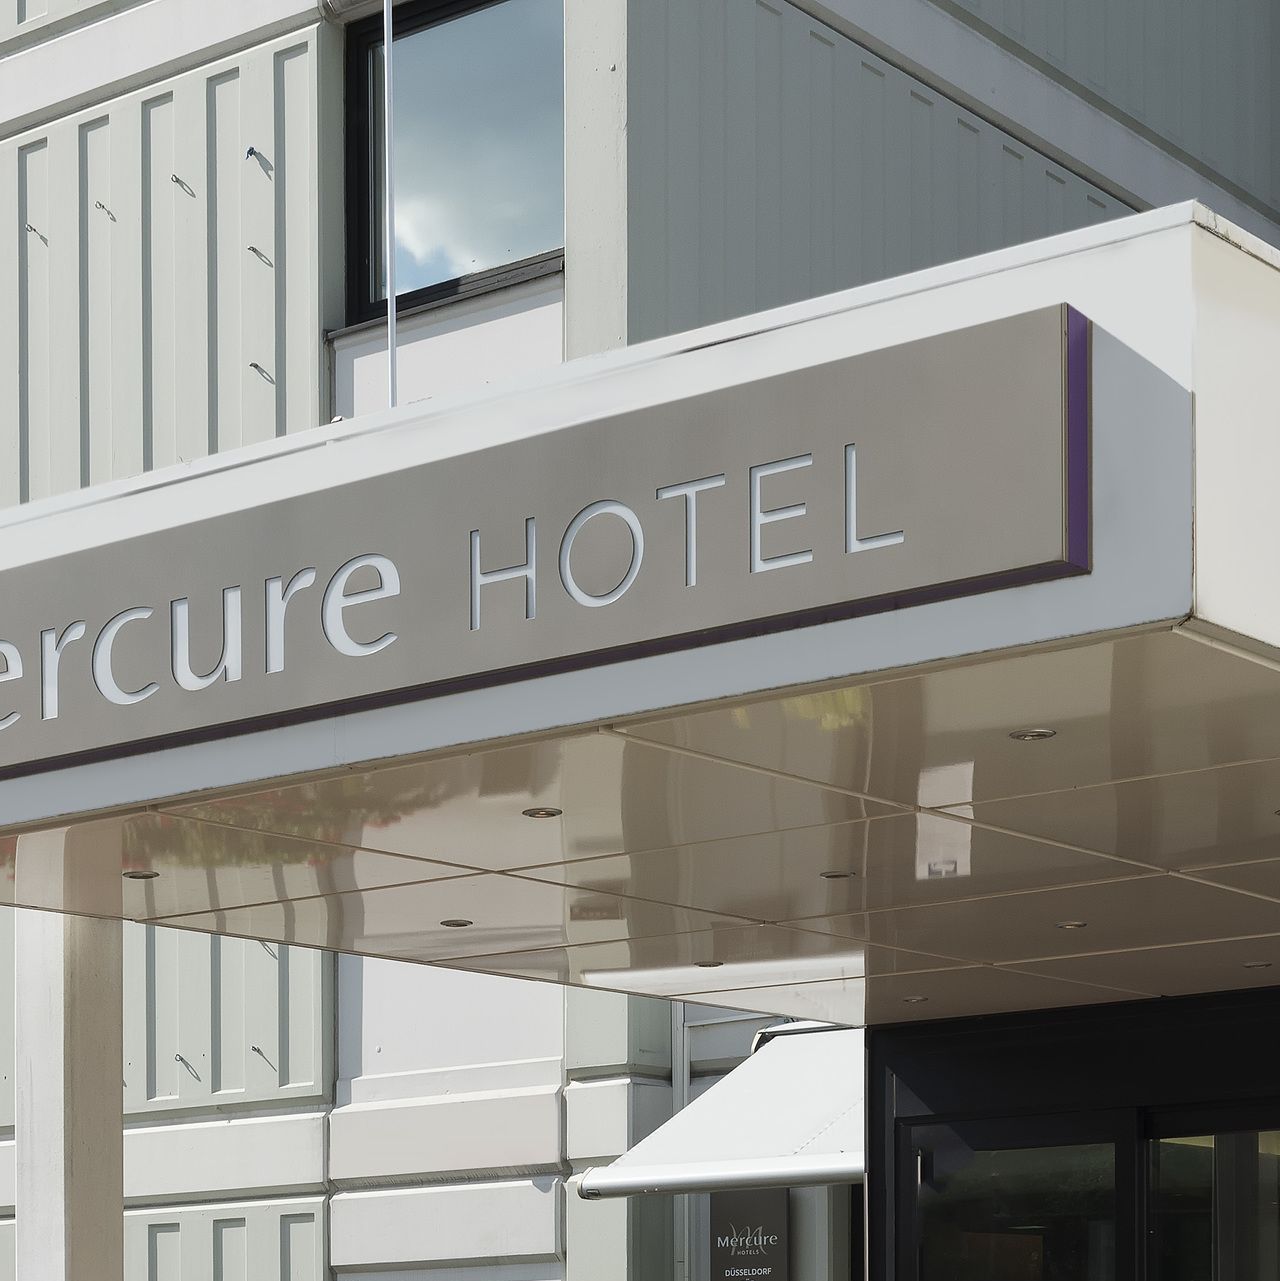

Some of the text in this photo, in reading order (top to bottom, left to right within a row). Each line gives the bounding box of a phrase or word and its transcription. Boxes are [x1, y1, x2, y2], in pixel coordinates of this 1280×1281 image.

[470, 442, 904, 631] HOTEL
[717, 1234, 778, 1248] Mercure
[724, 1267, 772, 1277] DÜSSELDORF
